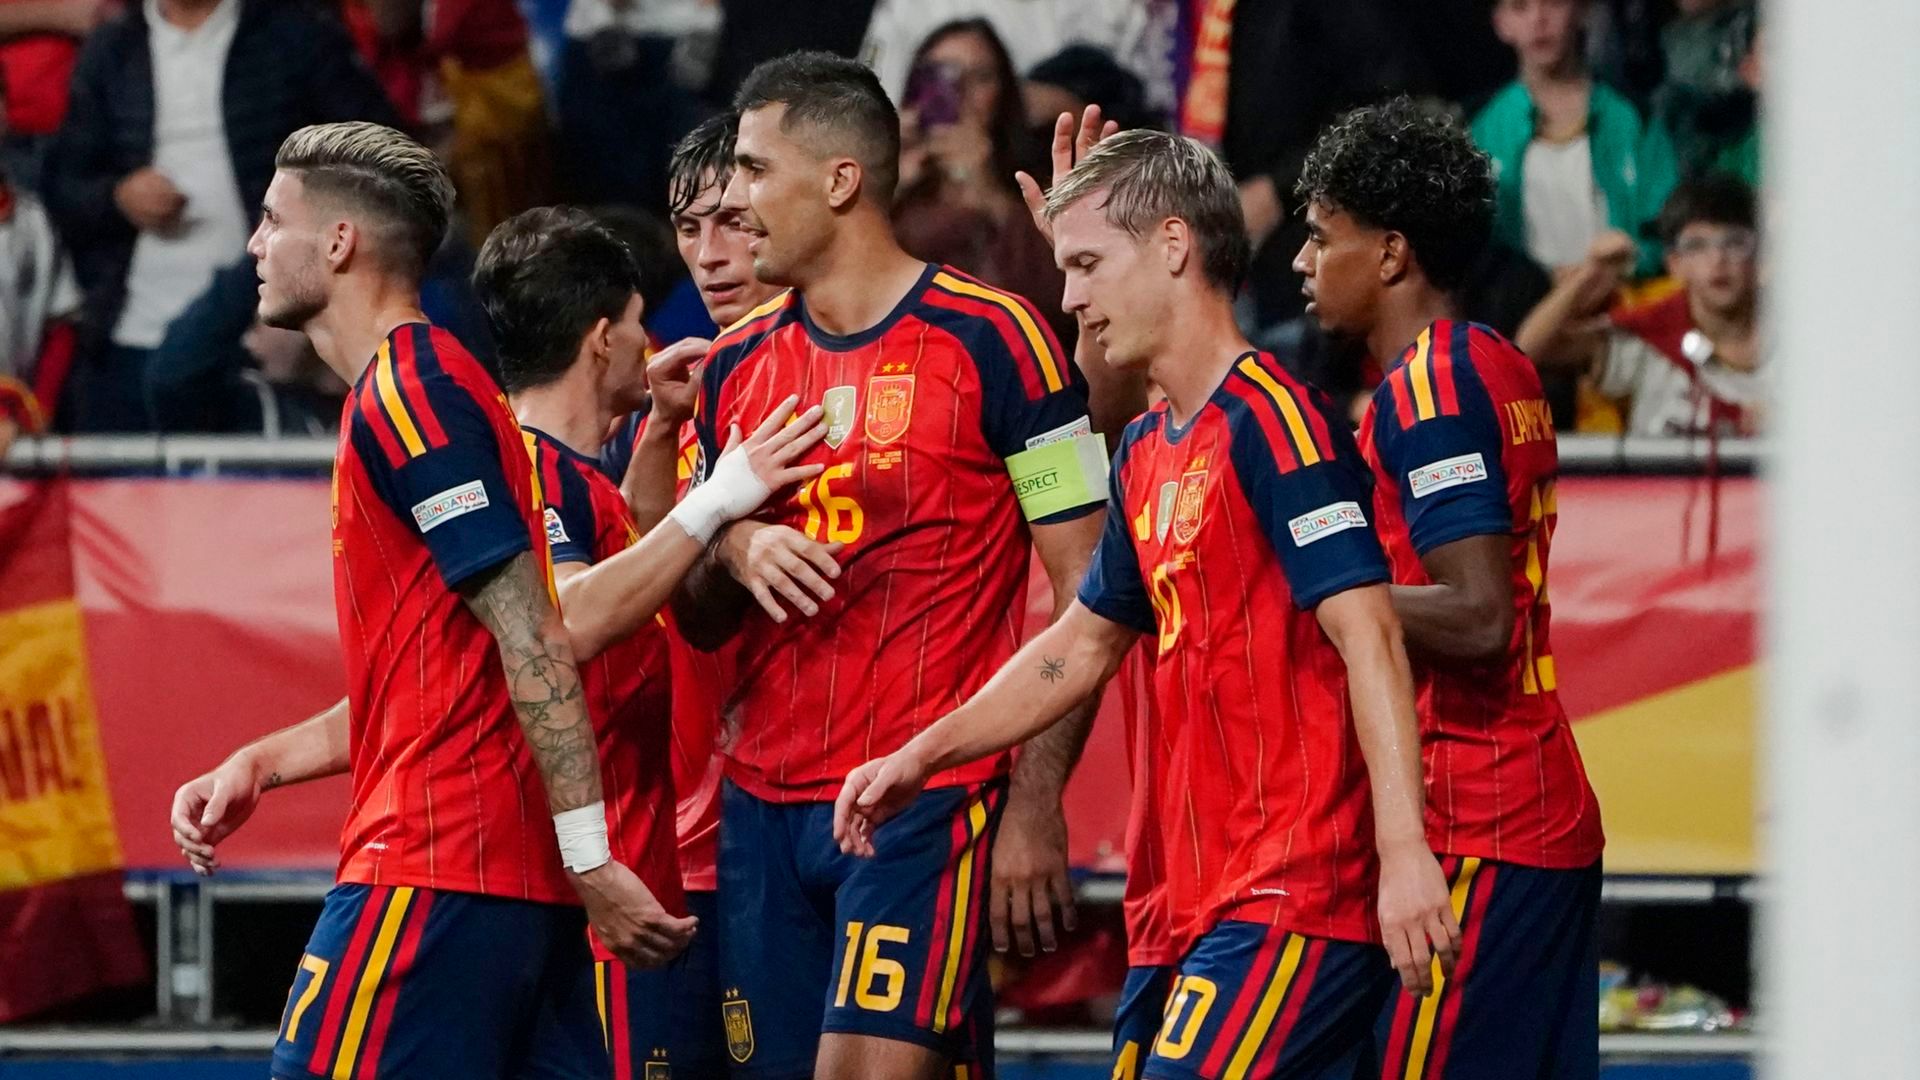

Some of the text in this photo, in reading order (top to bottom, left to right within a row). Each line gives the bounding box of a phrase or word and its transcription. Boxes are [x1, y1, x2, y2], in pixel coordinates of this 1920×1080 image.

[416, 489, 485, 522] FOUNDATION
[1412, 462, 1483, 489] FOUNDATION
[280, 952, 330, 1043] 7
[833, 921, 911, 1012] 16
[1151, 975, 1217, 1060] 0
